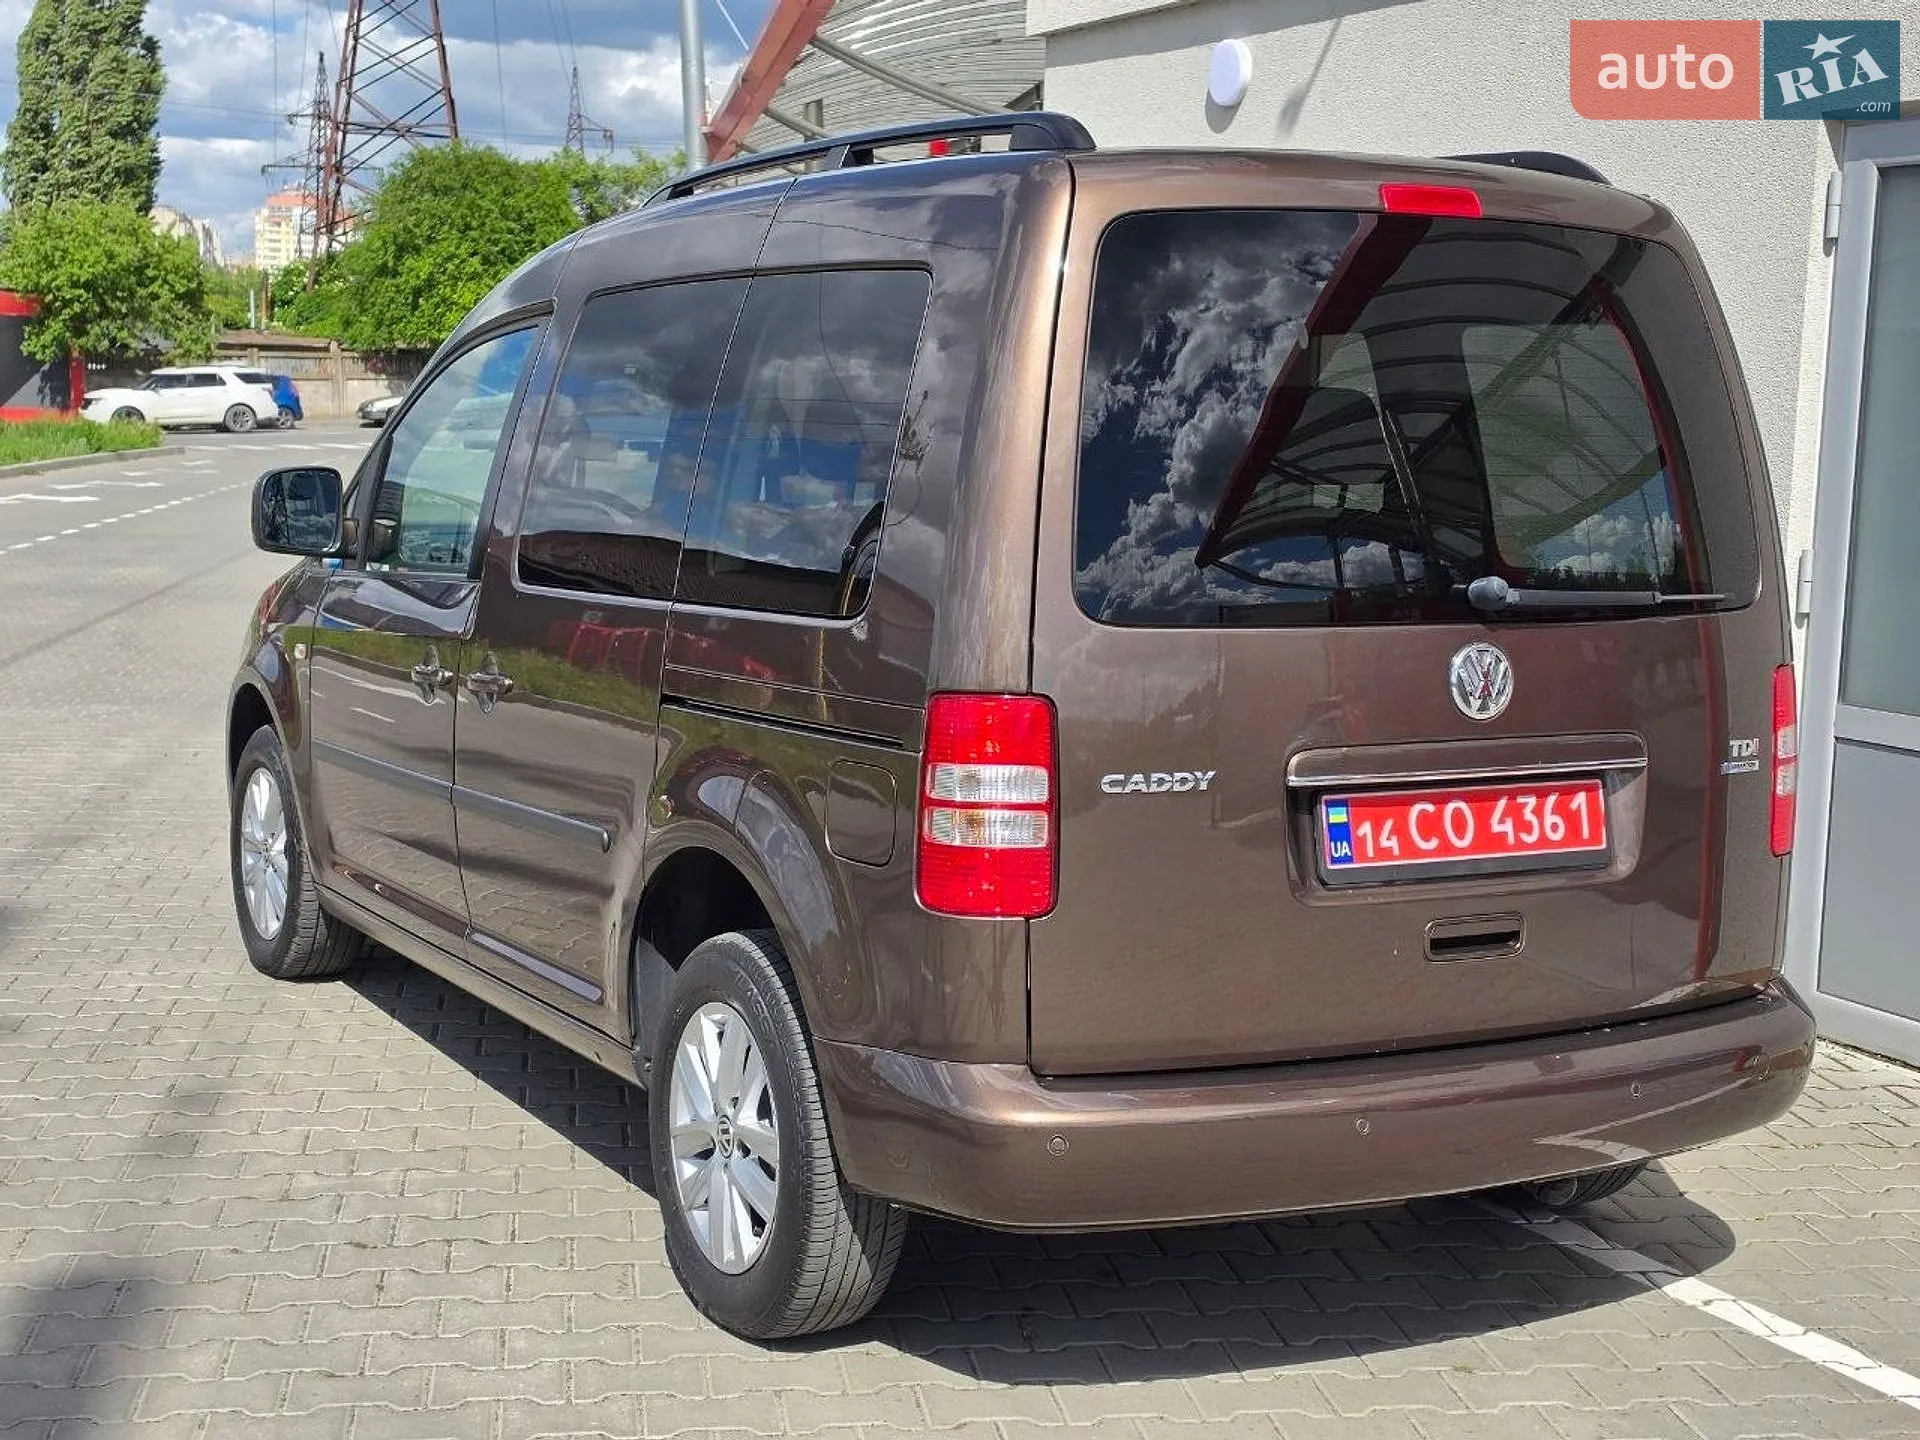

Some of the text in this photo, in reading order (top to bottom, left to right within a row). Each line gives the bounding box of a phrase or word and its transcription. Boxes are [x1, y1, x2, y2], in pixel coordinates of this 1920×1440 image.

[1729, 737, 1760, 758] TDI
[1100, 770, 1216, 794] CADDY
[1356, 790, 1590, 858] 14 CO 4361
[1330, 840, 1352, 858] UA
